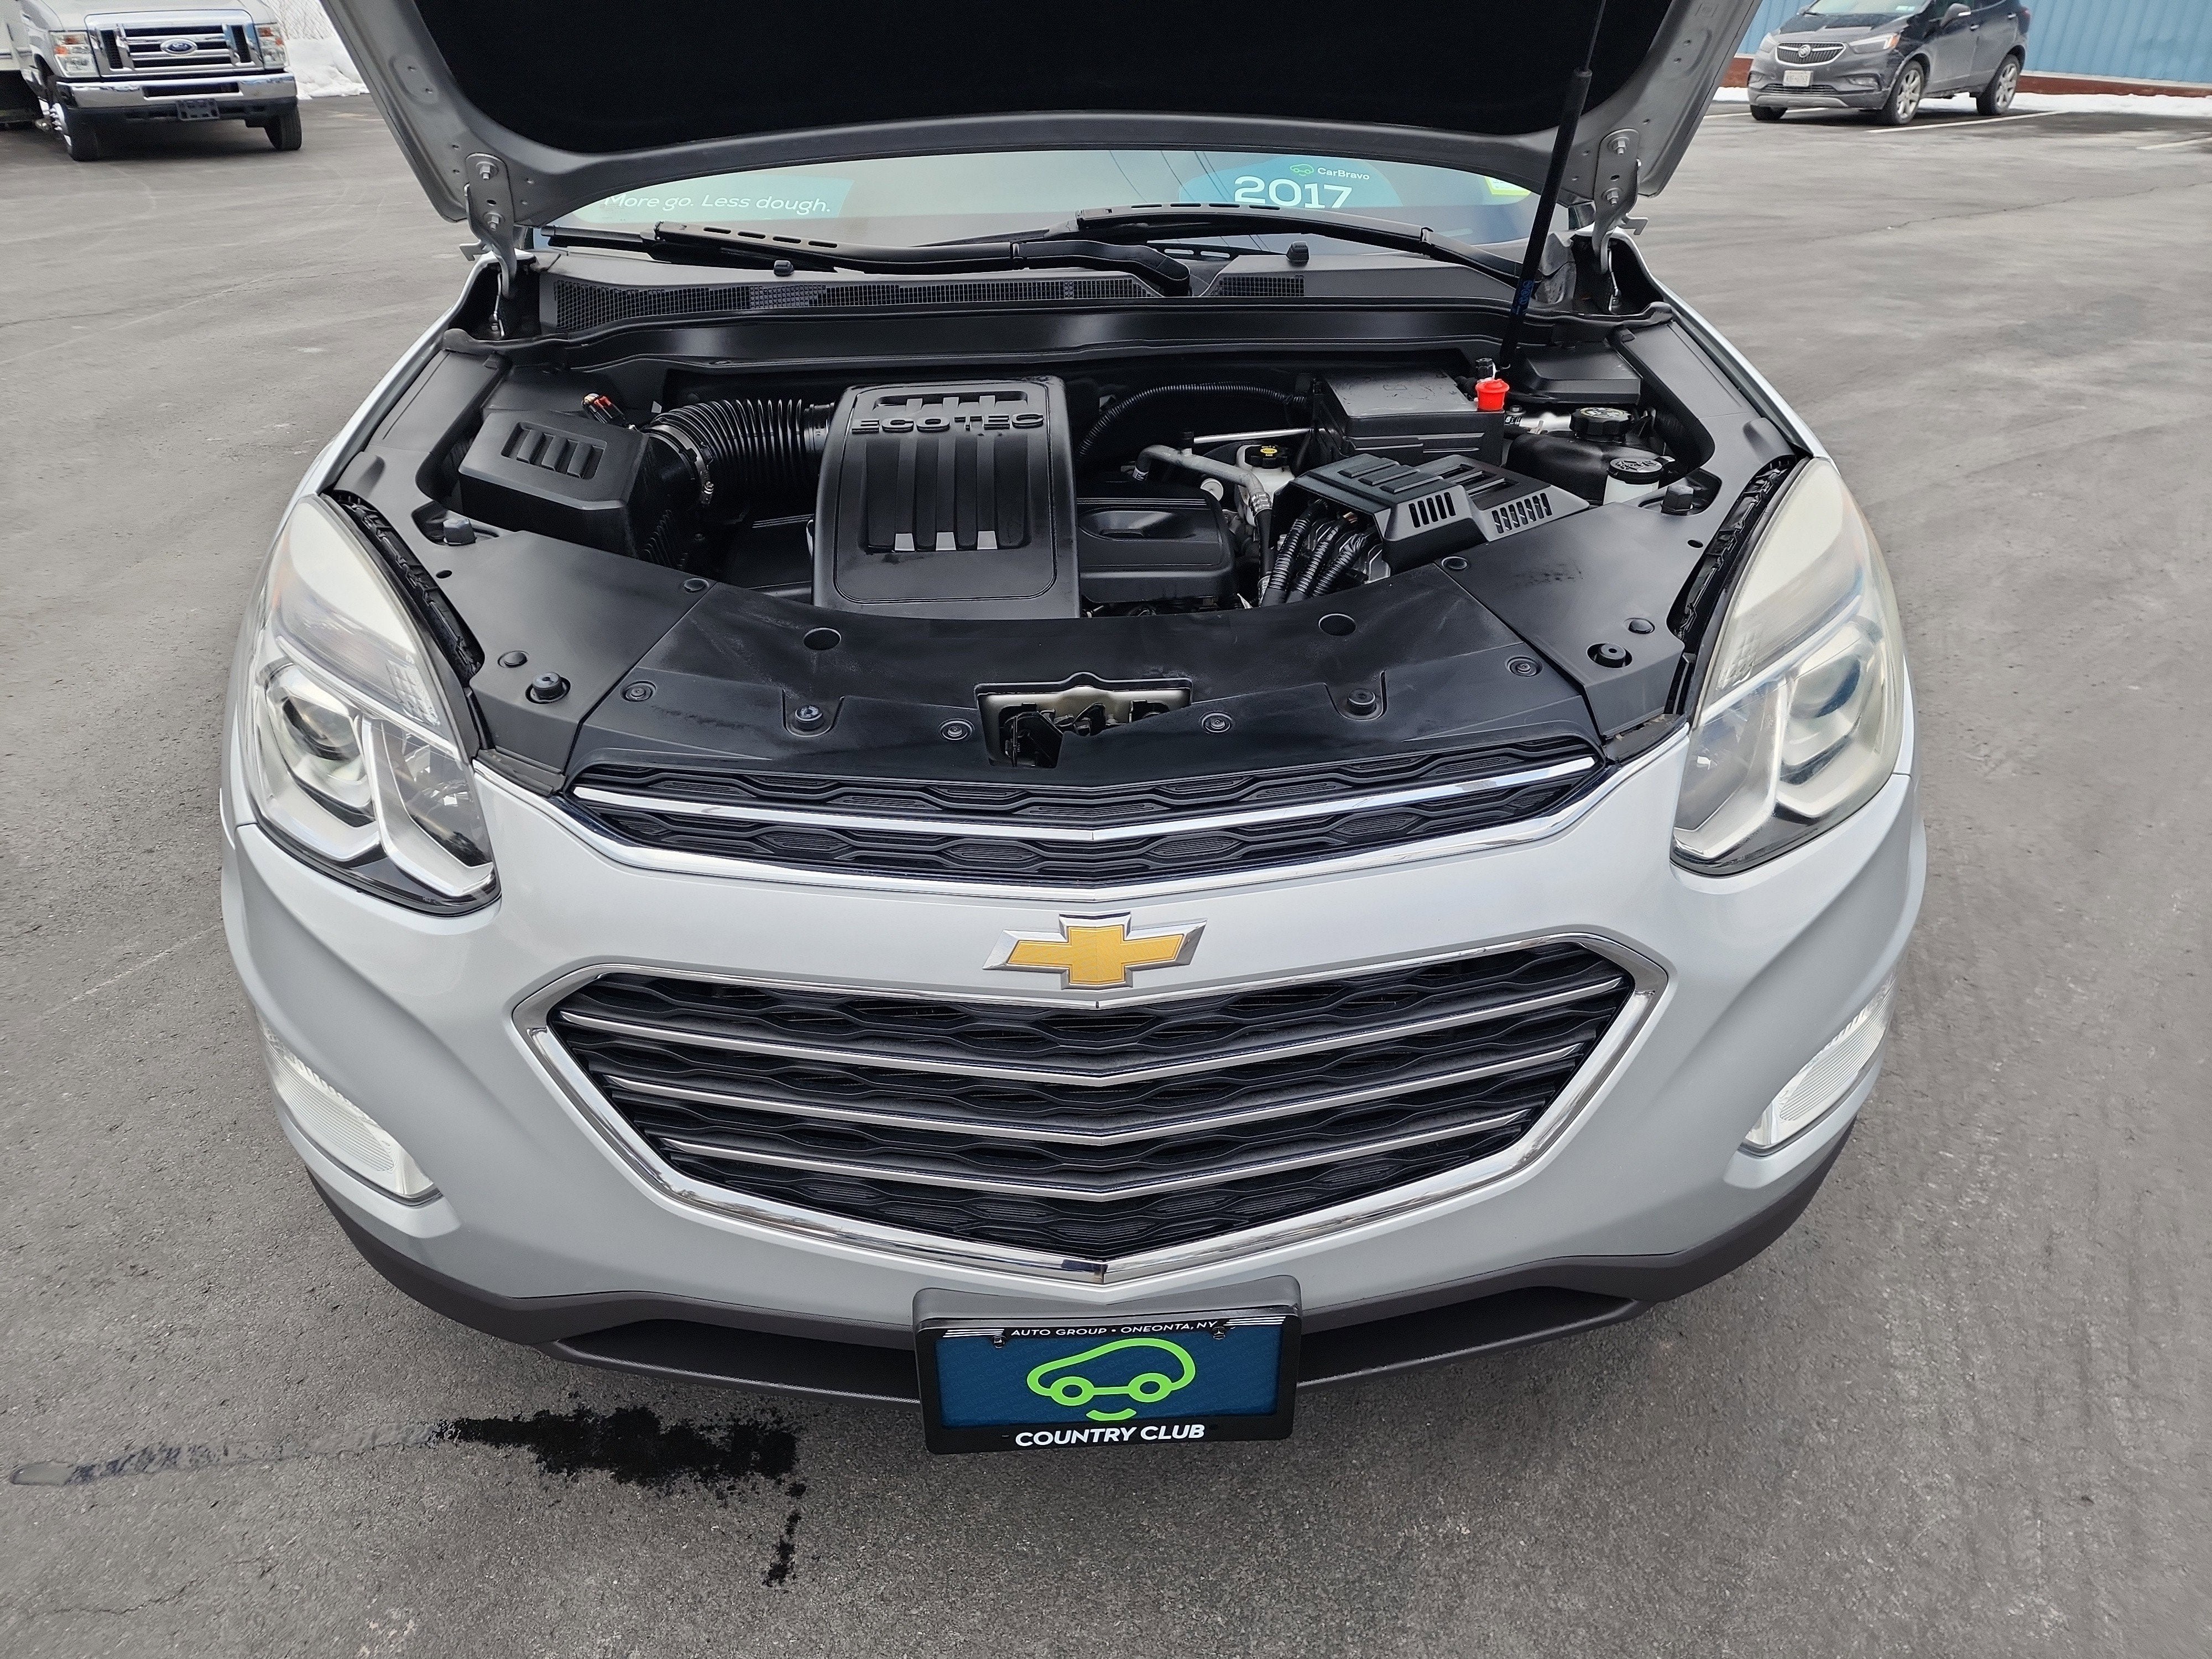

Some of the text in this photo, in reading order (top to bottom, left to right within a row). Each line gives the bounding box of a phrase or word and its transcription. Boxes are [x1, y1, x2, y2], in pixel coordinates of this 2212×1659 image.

[1317, 167, 1370, 180] CarBravo
[1234, 176, 1353, 208] 2017
[604, 194, 660, 207] More
[662, 197, 694, 211] go.
[701, 194, 751, 207] Less
[755, 196, 830, 215] dough.
[852, 413, 1044, 434] ECOTEC
[1015, 1424, 1205, 1447] COUNTRY CLUB
